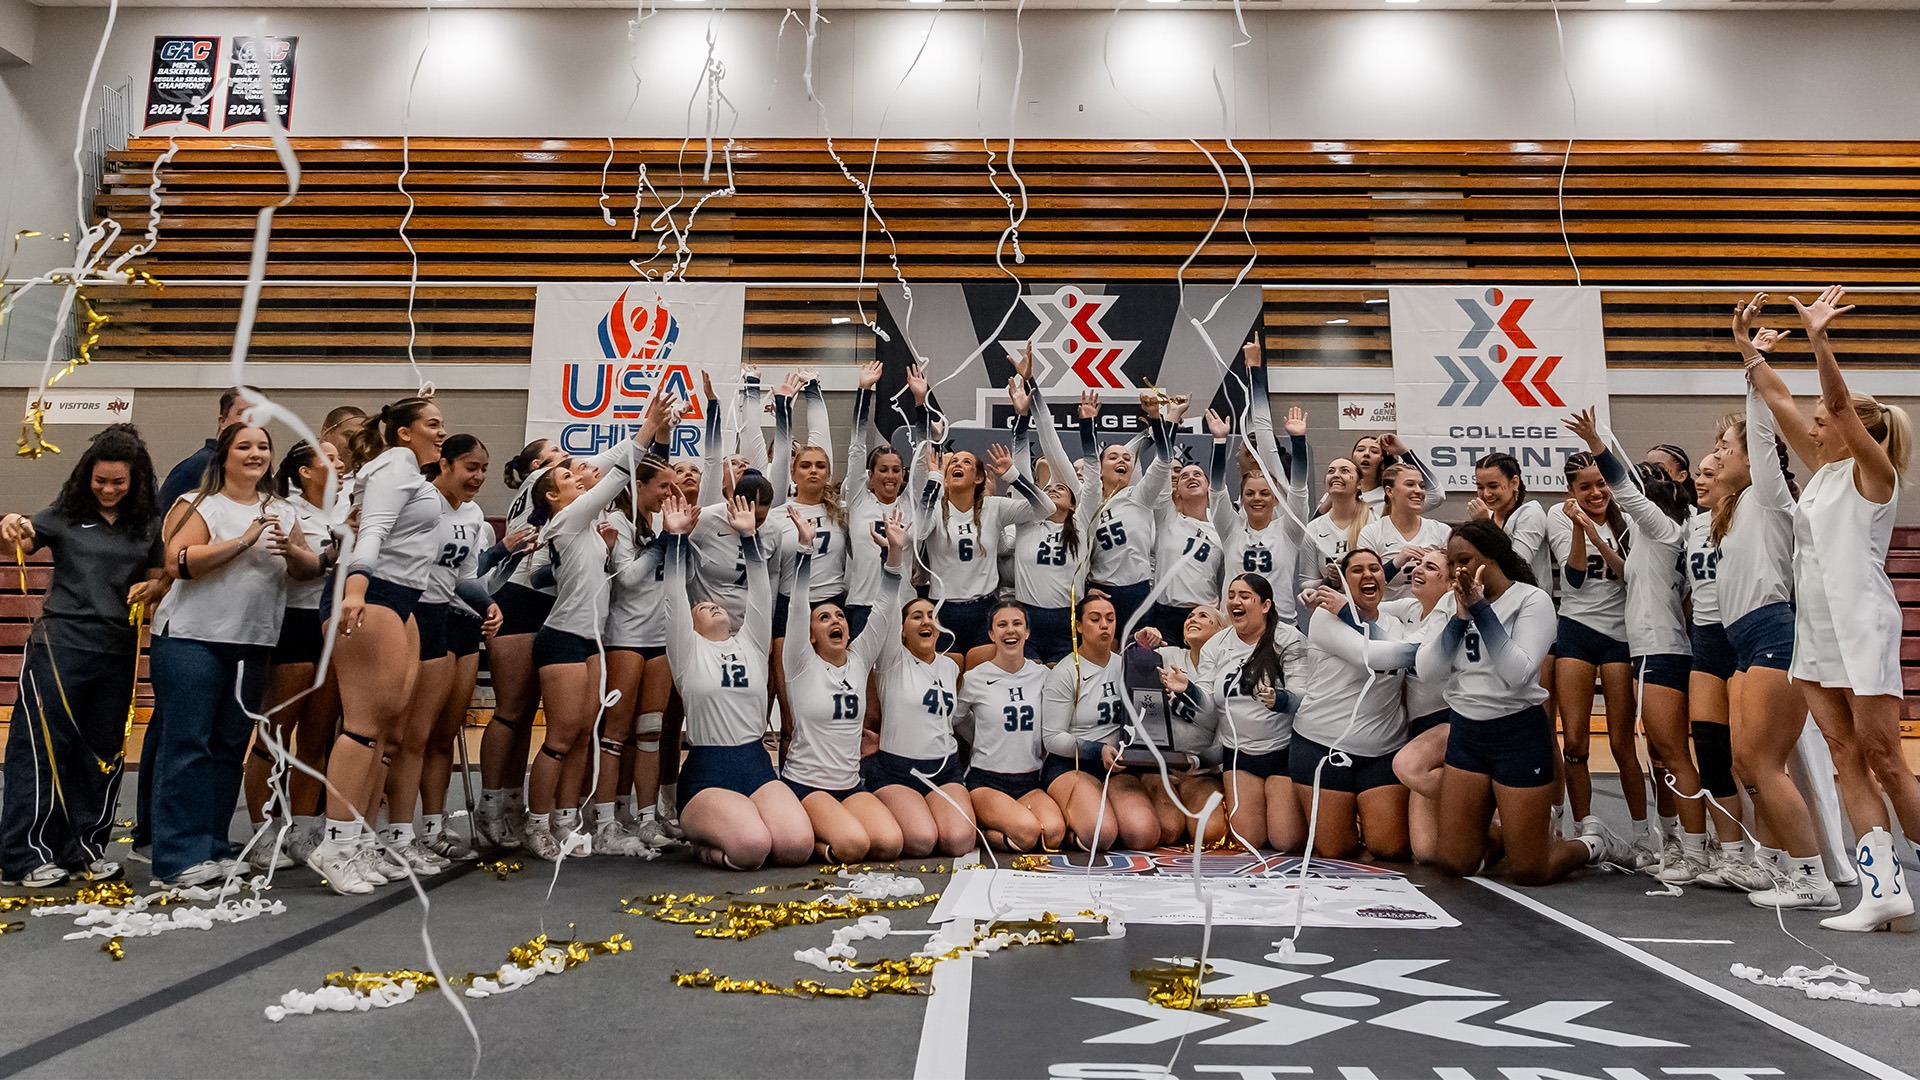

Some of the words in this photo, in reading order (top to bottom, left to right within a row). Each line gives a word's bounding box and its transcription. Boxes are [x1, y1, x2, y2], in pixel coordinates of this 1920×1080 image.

[161, 41, 212, 60] GAC
[149, 104, 182, 114] 2024
[192, 104, 209, 114] 25
[228, 105, 260, 115] 2024
[561, 363, 704, 419] USA
[106, 400, 129, 411] SNU
[1342, 406, 1364, 418] SNU
[1450, 426, 1558, 438] COLLEGE
[452, 524, 466, 540] H
[816, 531, 830, 554] 7
[1096, 521, 1127, 550] 55
[438, 543, 470, 568] 22
[958, 538, 973, 562] 6
[1036, 540, 1066, 566] 23
[1243, 550, 1272, 572] 63
[1465, 633, 1481, 662] 9
[721, 664, 748, 688] 12
[1008, 687, 1024, 702] H
[1101, 681, 1118, 698] H
[832, 694, 858, 720] 19
[922, 688, 954, 717] 45
[1003, 705, 1034, 732] 32
